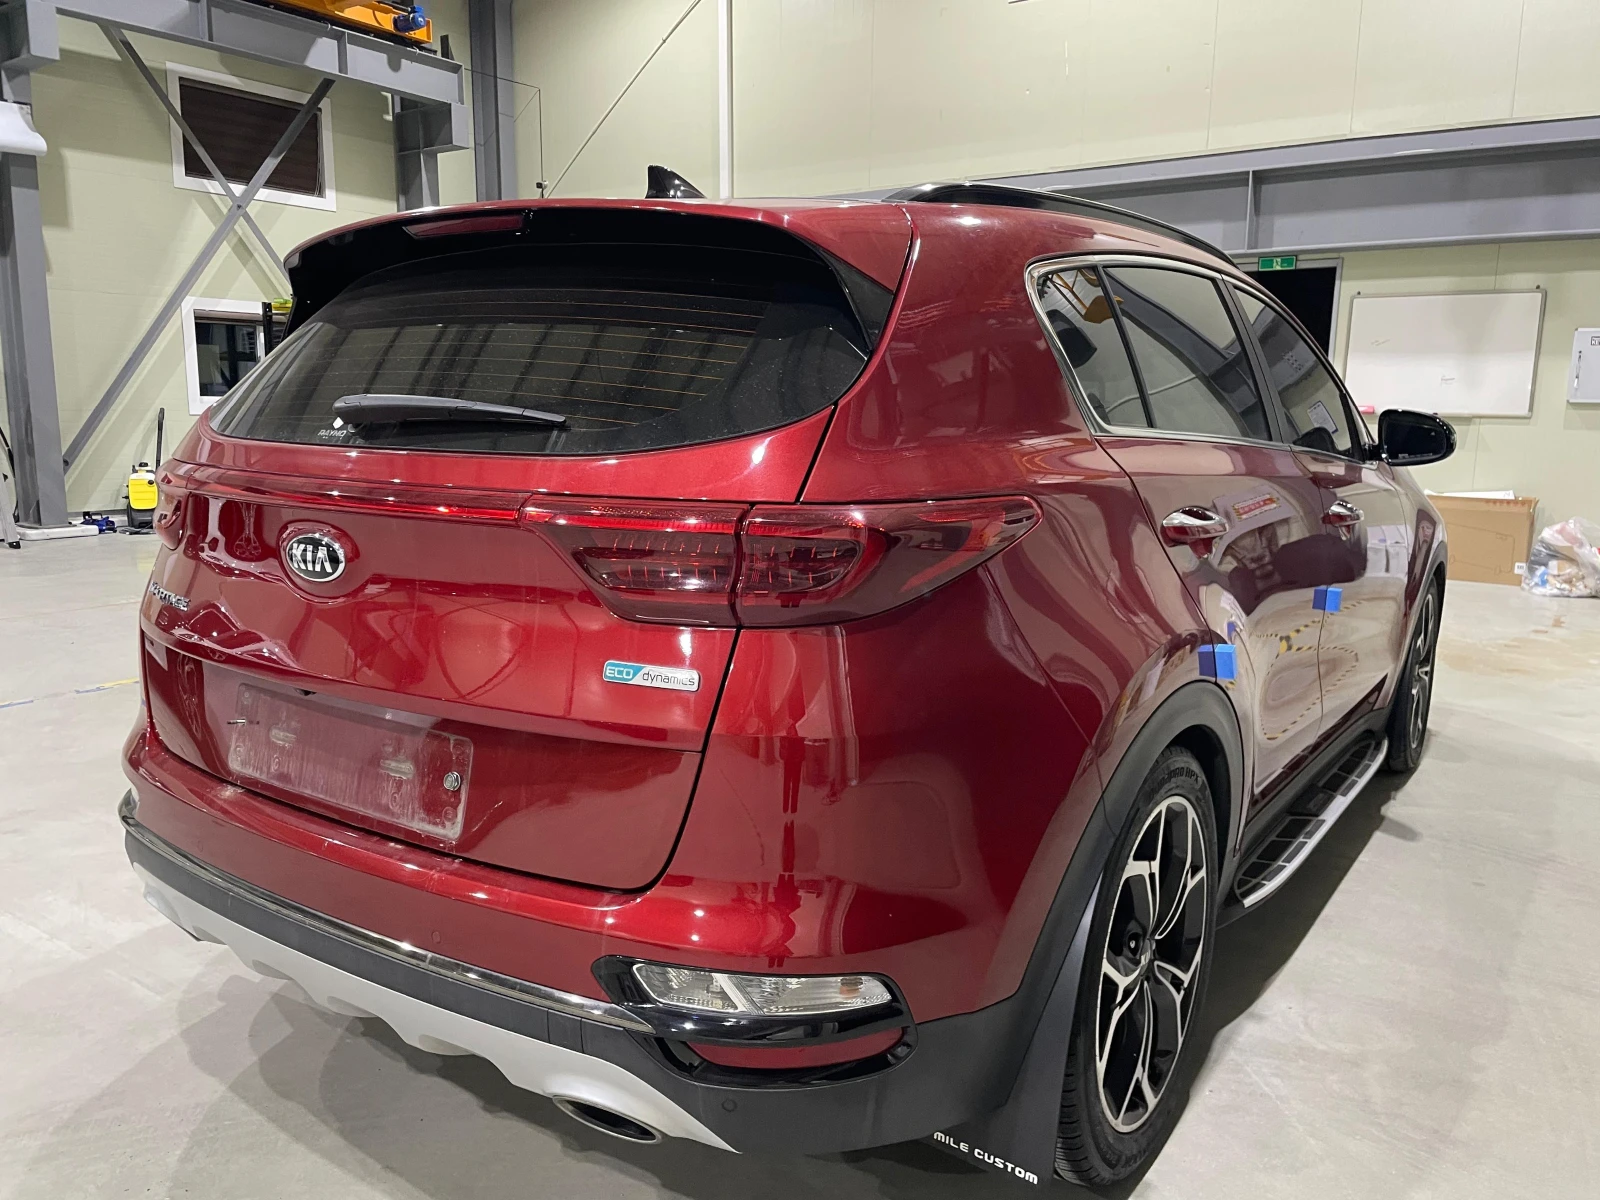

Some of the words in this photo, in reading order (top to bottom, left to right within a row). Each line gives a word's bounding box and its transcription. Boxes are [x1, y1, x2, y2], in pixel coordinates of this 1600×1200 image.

[292, 542, 334, 573] KIA
[605, 665, 634, 679] ECO
[642, 670, 696, 687] dynamics
[933, 1131, 970, 1153] MILE
[974, 1148, 1039, 1185] CUSTOM
